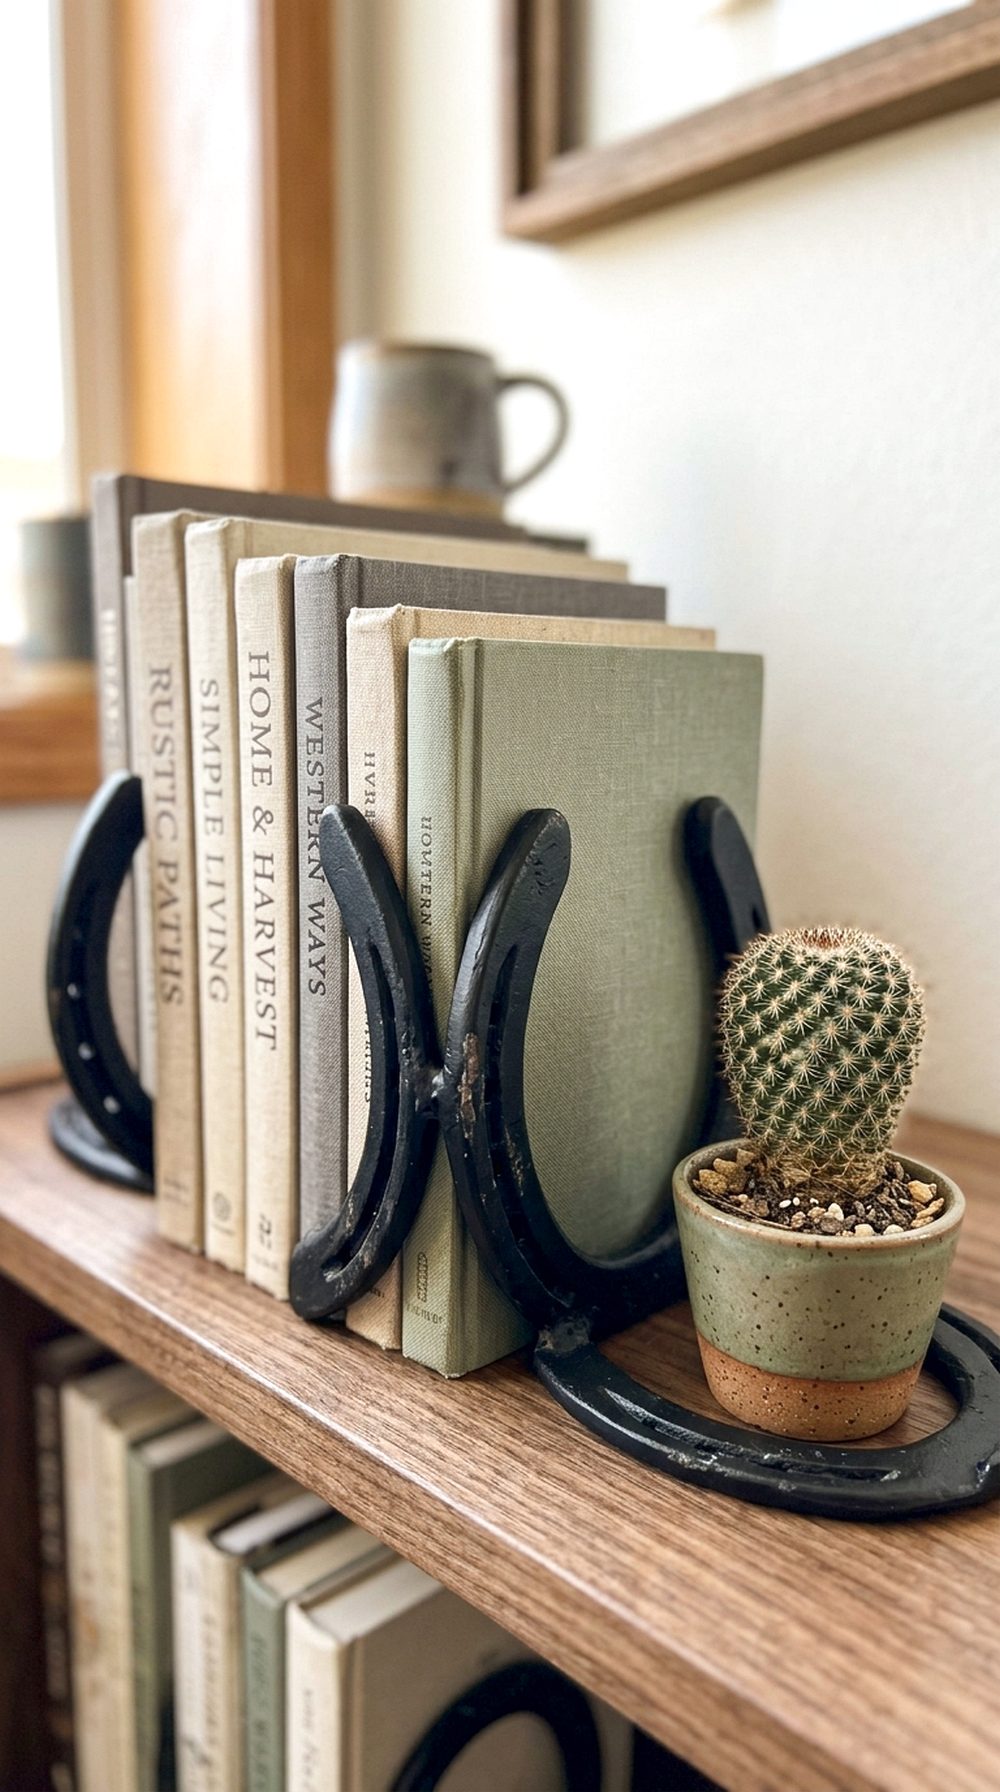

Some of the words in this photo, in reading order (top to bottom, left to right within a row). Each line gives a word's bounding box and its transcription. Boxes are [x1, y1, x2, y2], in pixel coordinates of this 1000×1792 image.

[150, 662, 179, 841] RUSTIC
[201, 678, 224, 836] SIMPLE
[248, 651, 273, 787] HOME
[305, 697, 325, 882] WESTERN
[252, 805, 274, 836] &
[157, 859, 184, 1005] PATHS
[205, 854, 229, 1004] LIVING
[253, 852, 277, 1051] HARVEST
[307, 897, 326, 996] WAYS
